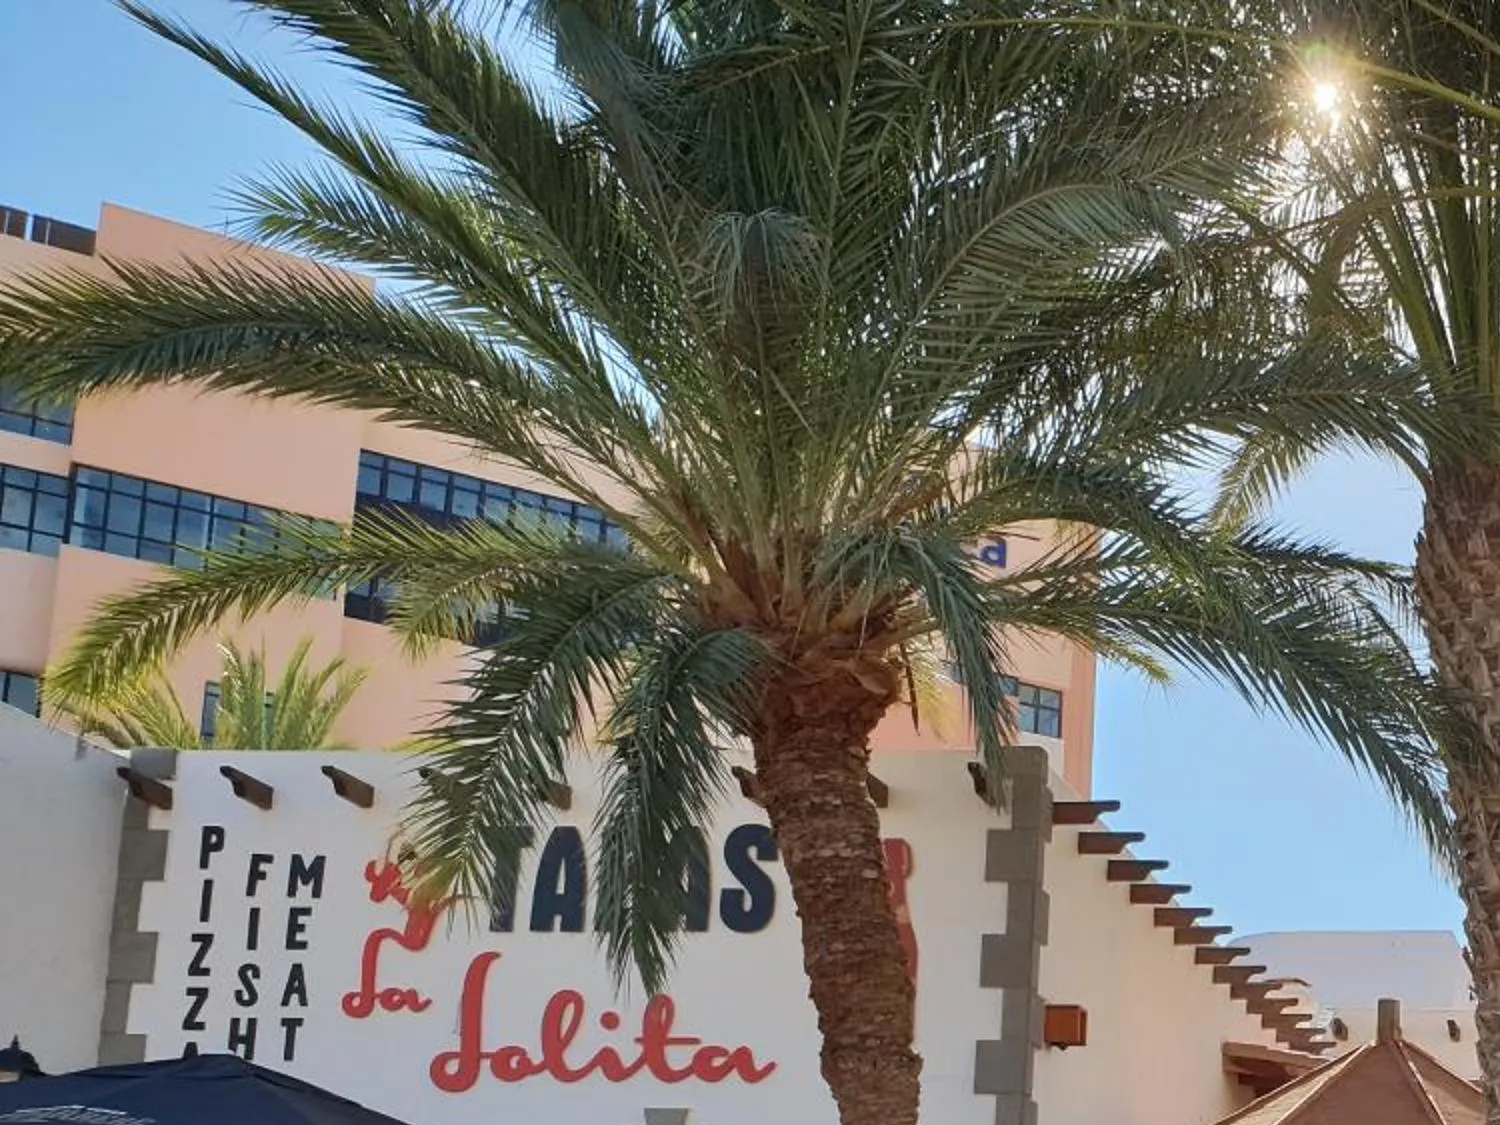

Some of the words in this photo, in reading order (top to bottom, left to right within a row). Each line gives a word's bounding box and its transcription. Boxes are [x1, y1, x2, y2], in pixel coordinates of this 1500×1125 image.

[227, 853, 274, 1061] FISH
[280, 853, 327, 1062] MEAT
[484, 824, 780, 934] TAAS
[341, 928, 432, 1019] La
[430, 951, 777, 1093] Lolita
